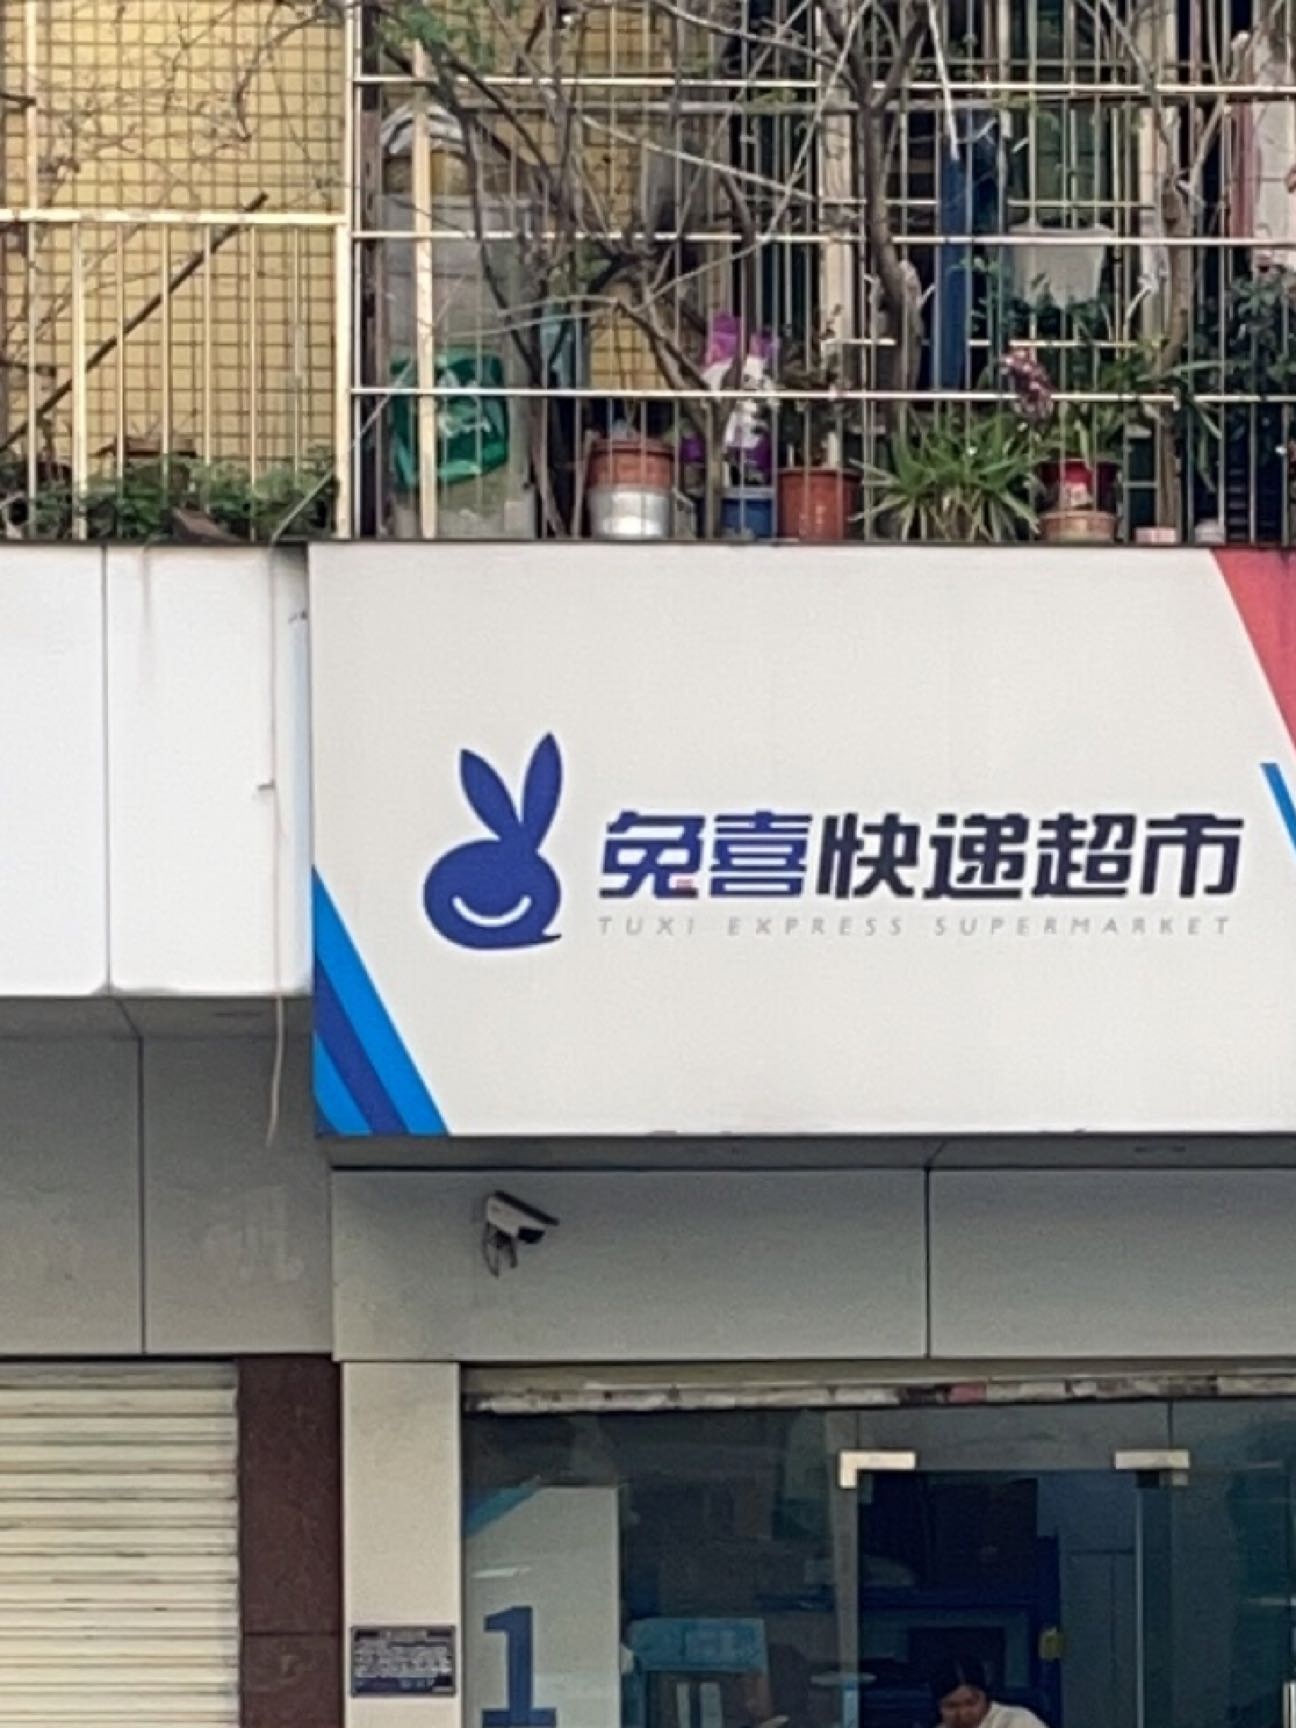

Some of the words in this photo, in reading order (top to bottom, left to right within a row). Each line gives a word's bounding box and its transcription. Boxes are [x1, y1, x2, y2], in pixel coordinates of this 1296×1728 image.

[599, 810, 1244, 899] 兔喜快递超市
[598, 915, 695, 937] TUXI
[727, 915, 902, 937] EXPRESS
[935, 915, 1230, 937] SUPERMARKET
[481, 1606, 557, 1728] 1
